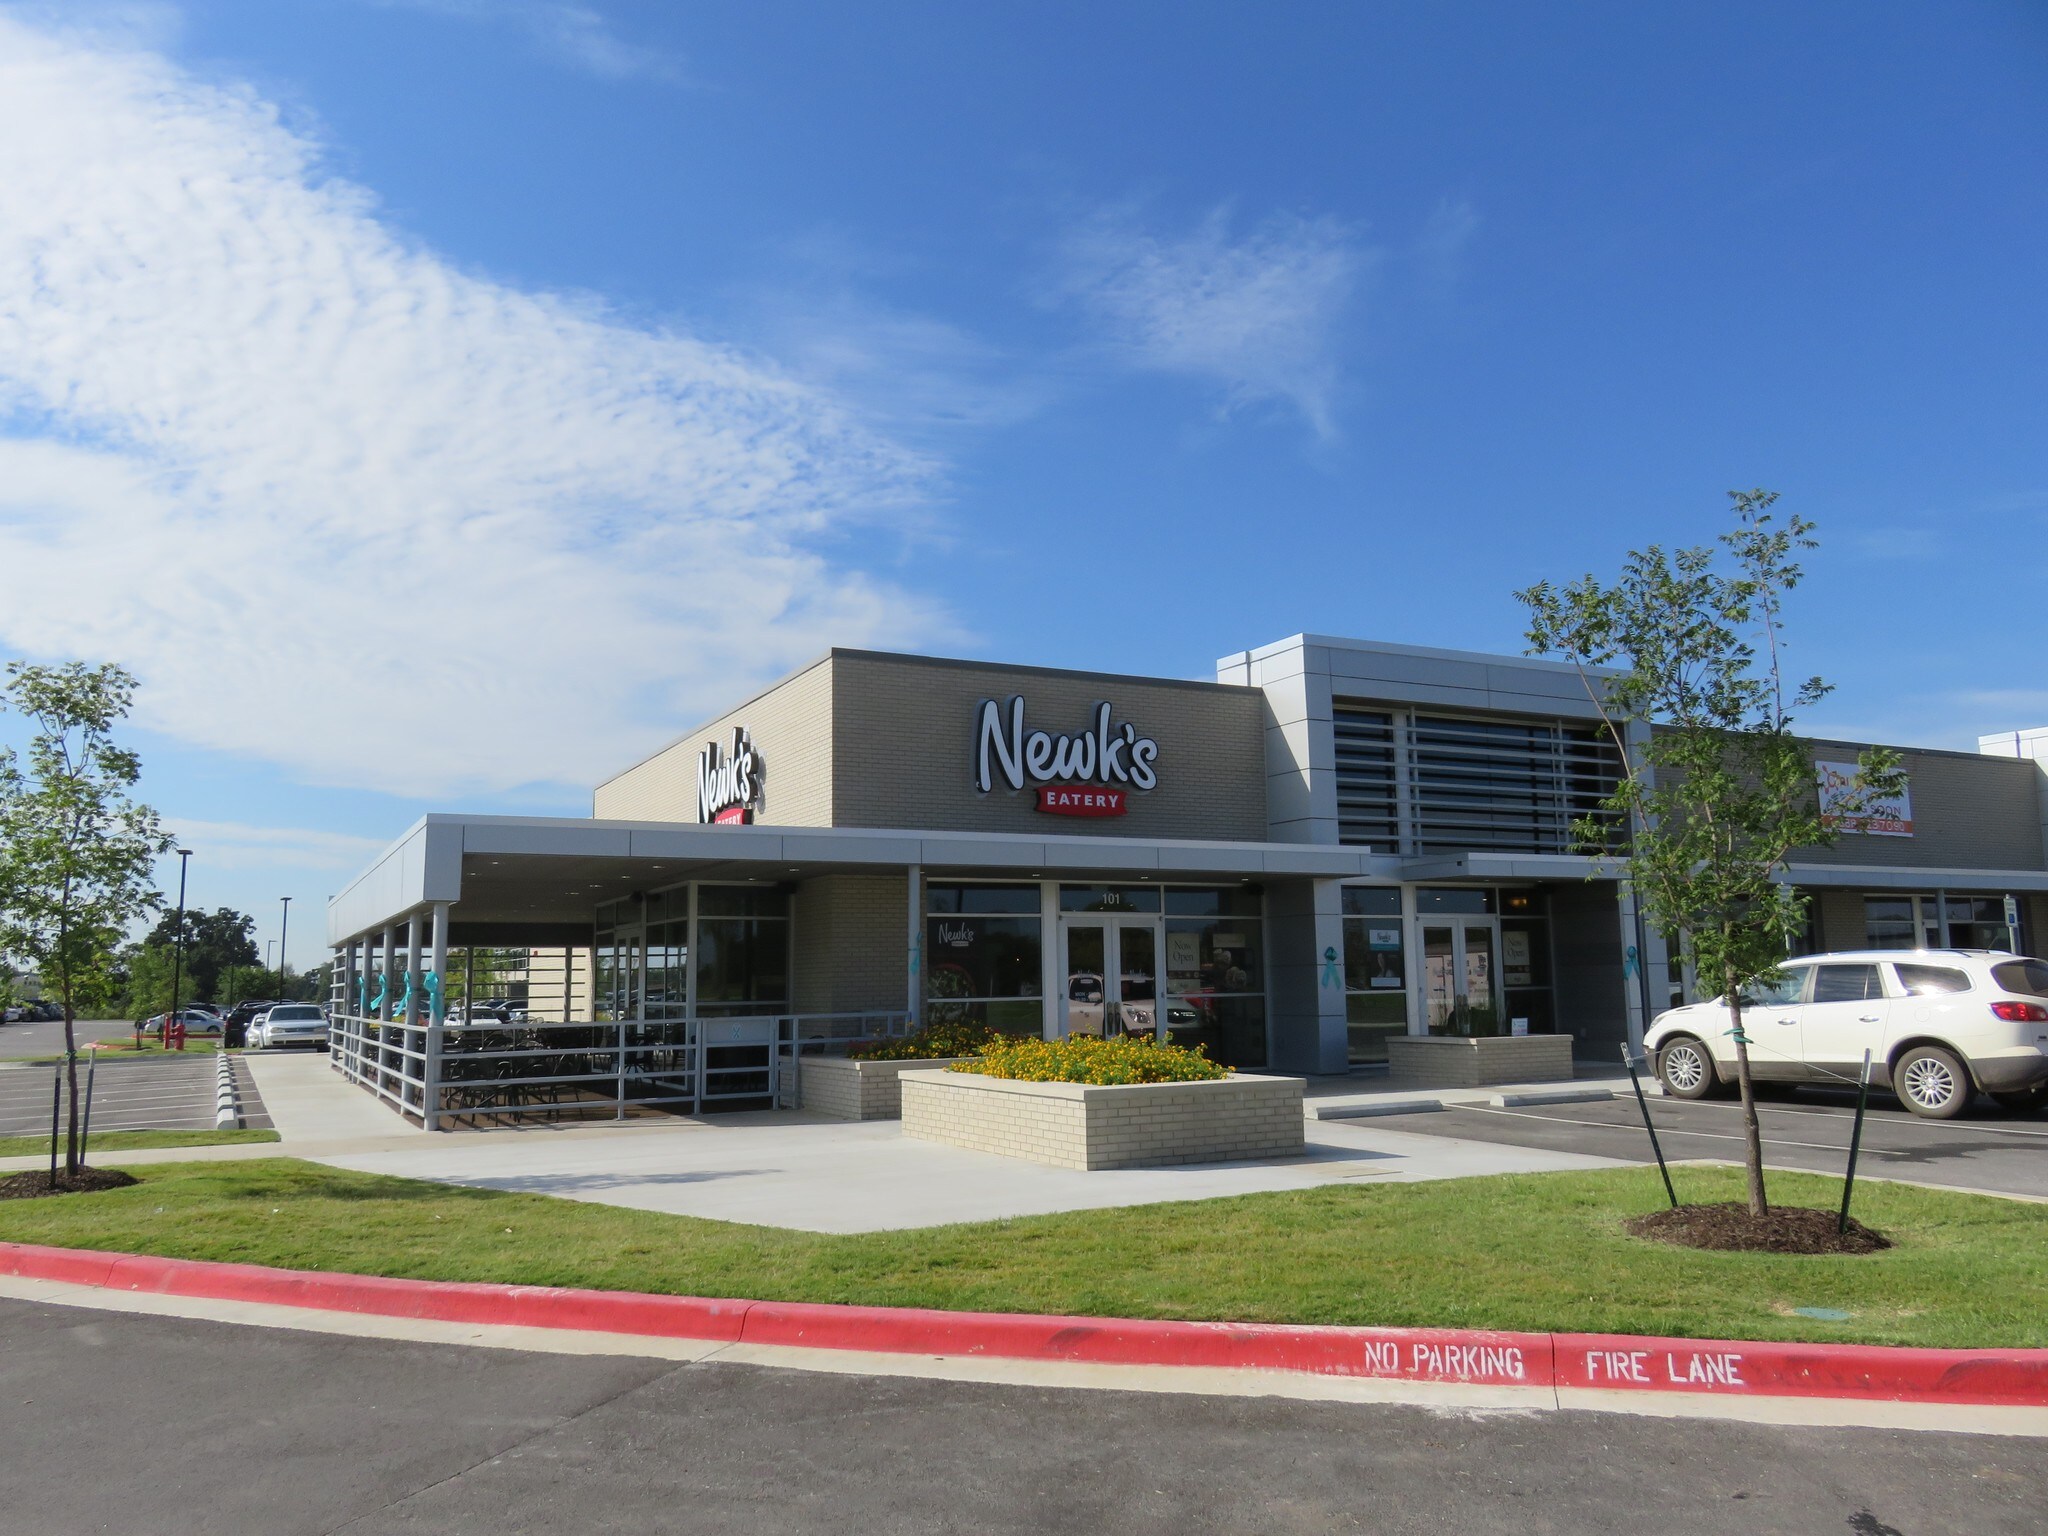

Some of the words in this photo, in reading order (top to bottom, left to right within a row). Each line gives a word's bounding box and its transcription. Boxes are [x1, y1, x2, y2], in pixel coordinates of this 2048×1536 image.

[977, 695, 1158, 793] Newk's
[696, 727, 752, 823] Newk's
[1047, 791, 1118, 808] EATERY
[1102, 893, 1120, 904] 101
[938, 921, 974, 944] Newk's
[1174, 940, 1192, 950] Now
[1173, 950, 1194, 965] Open
[1365, 1341, 1399, 1370] NO
[1412, 1343, 1524, 1379] PARKING
[1586, 1351, 1650, 1382] FIRE
[1667, 1352, 1744, 1385] LANE
